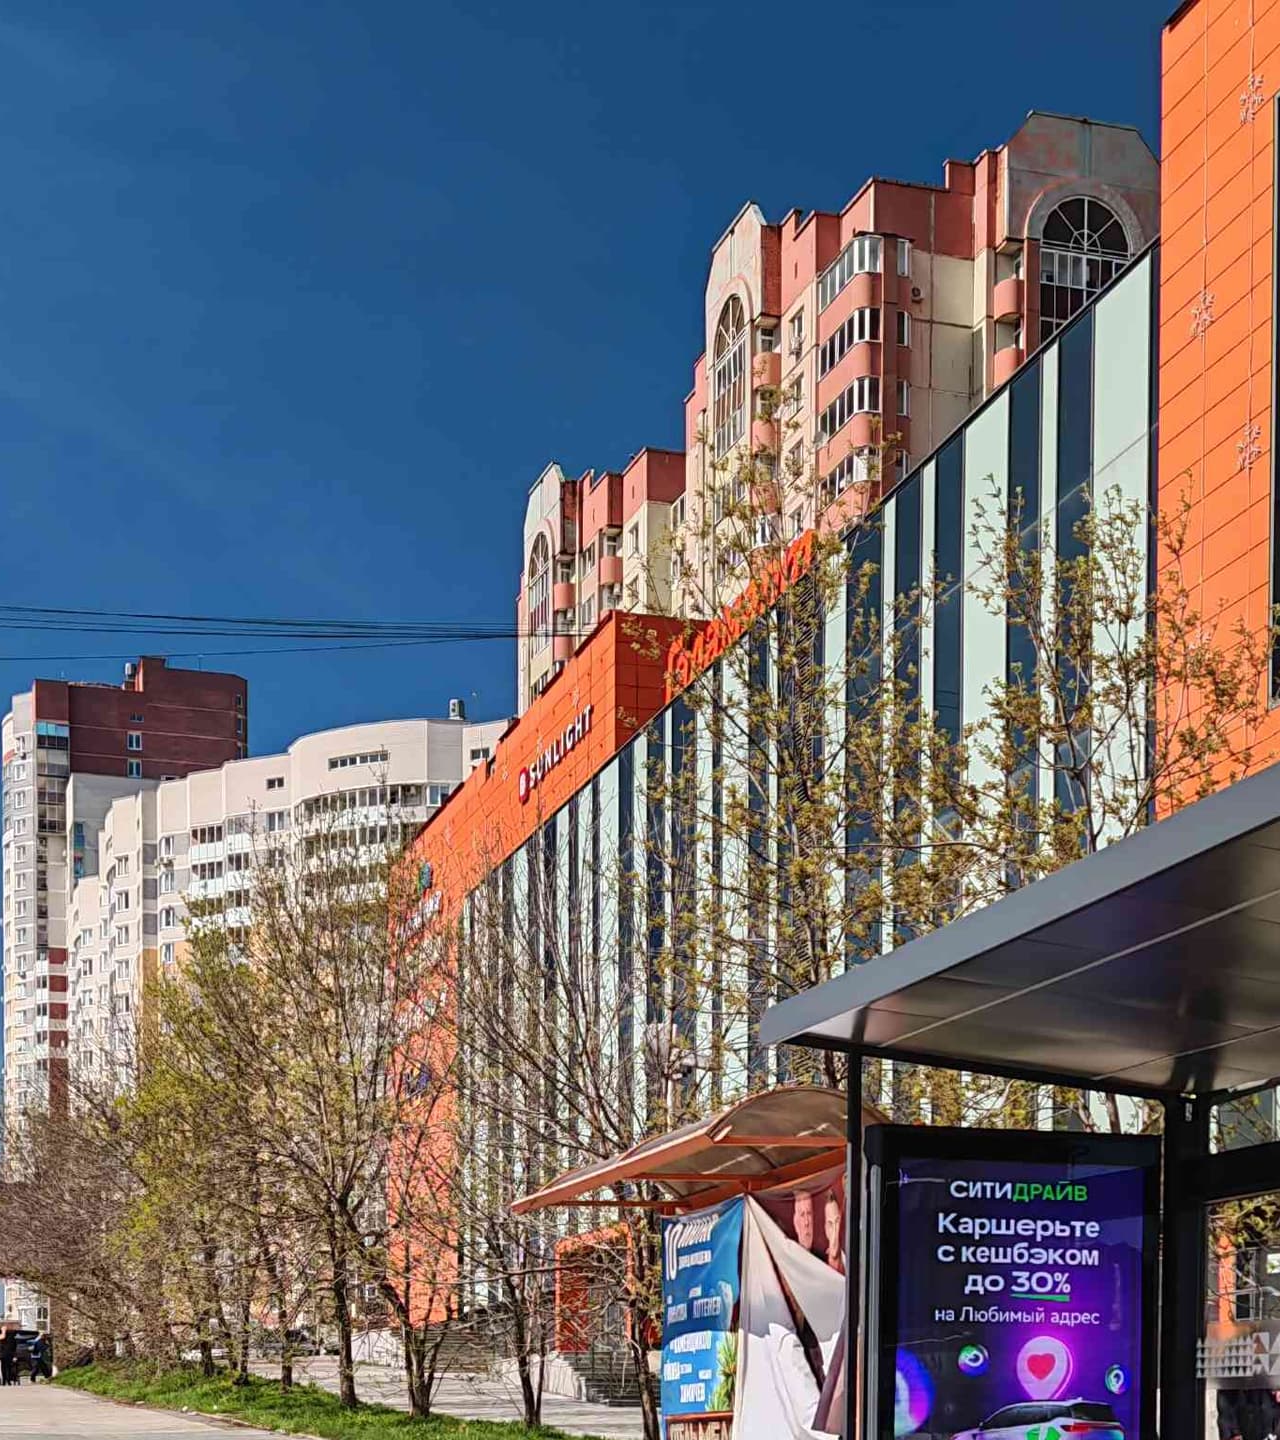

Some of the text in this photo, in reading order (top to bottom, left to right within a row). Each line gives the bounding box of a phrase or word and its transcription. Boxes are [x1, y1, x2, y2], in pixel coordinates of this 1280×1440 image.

[529, 703, 592, 790] SUNLIGHT
[949, 1180, 1088, 1202] СИТИДРАЙВ
[937, 1212, 1100, 1241] Каршерьте
[936, 1242, 1100, 1266] с кешбэком
[964, 1271, 1071, 1295] до 30%
[934, 1306, 1101, 1327] на Любимый адрес
